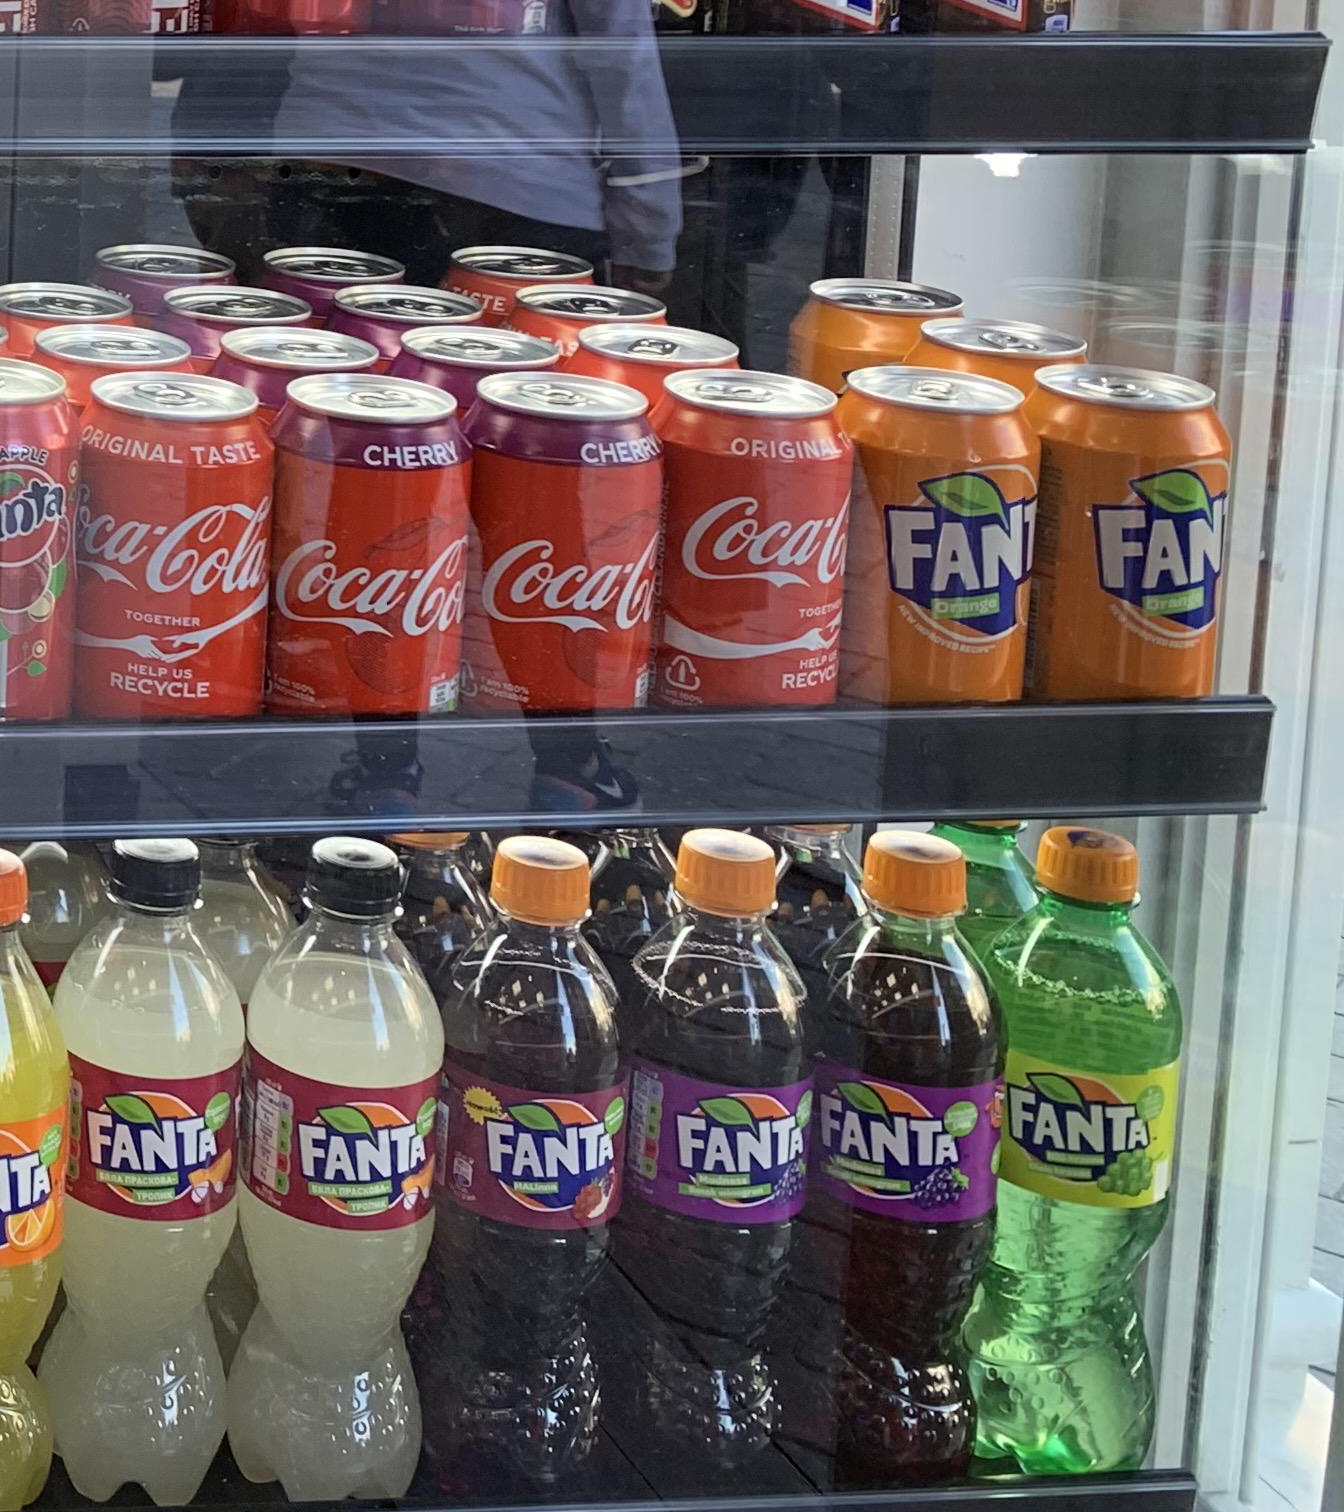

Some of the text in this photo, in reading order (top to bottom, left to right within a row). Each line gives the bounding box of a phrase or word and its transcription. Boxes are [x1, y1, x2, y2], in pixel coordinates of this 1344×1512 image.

[81, 424, 261, 466] ORIGINAL TASTE
[362, 439, 458, 468] CHERRY
[580, 435, 660, 467] CHERRY
[730, 436, 841, 462] ORIGINAL
[124, 609, 201, 628] TOGETHER
[933, 598, 999, 617] Orange
[109, 672, 210, 698] RECYCLE
[127, 661, 193, 679] HELP US
[819, 1093, 959, 1167] FANTA
[1011, 1086, 1149, 1152] FANTA
[86, 1110, 217, 1172] FANTA
[297, 1122, 424, 1181] FANTA
[486, 1120, 614, 1178] FANTA
[677, 1112, 805, 1174] FANTA
